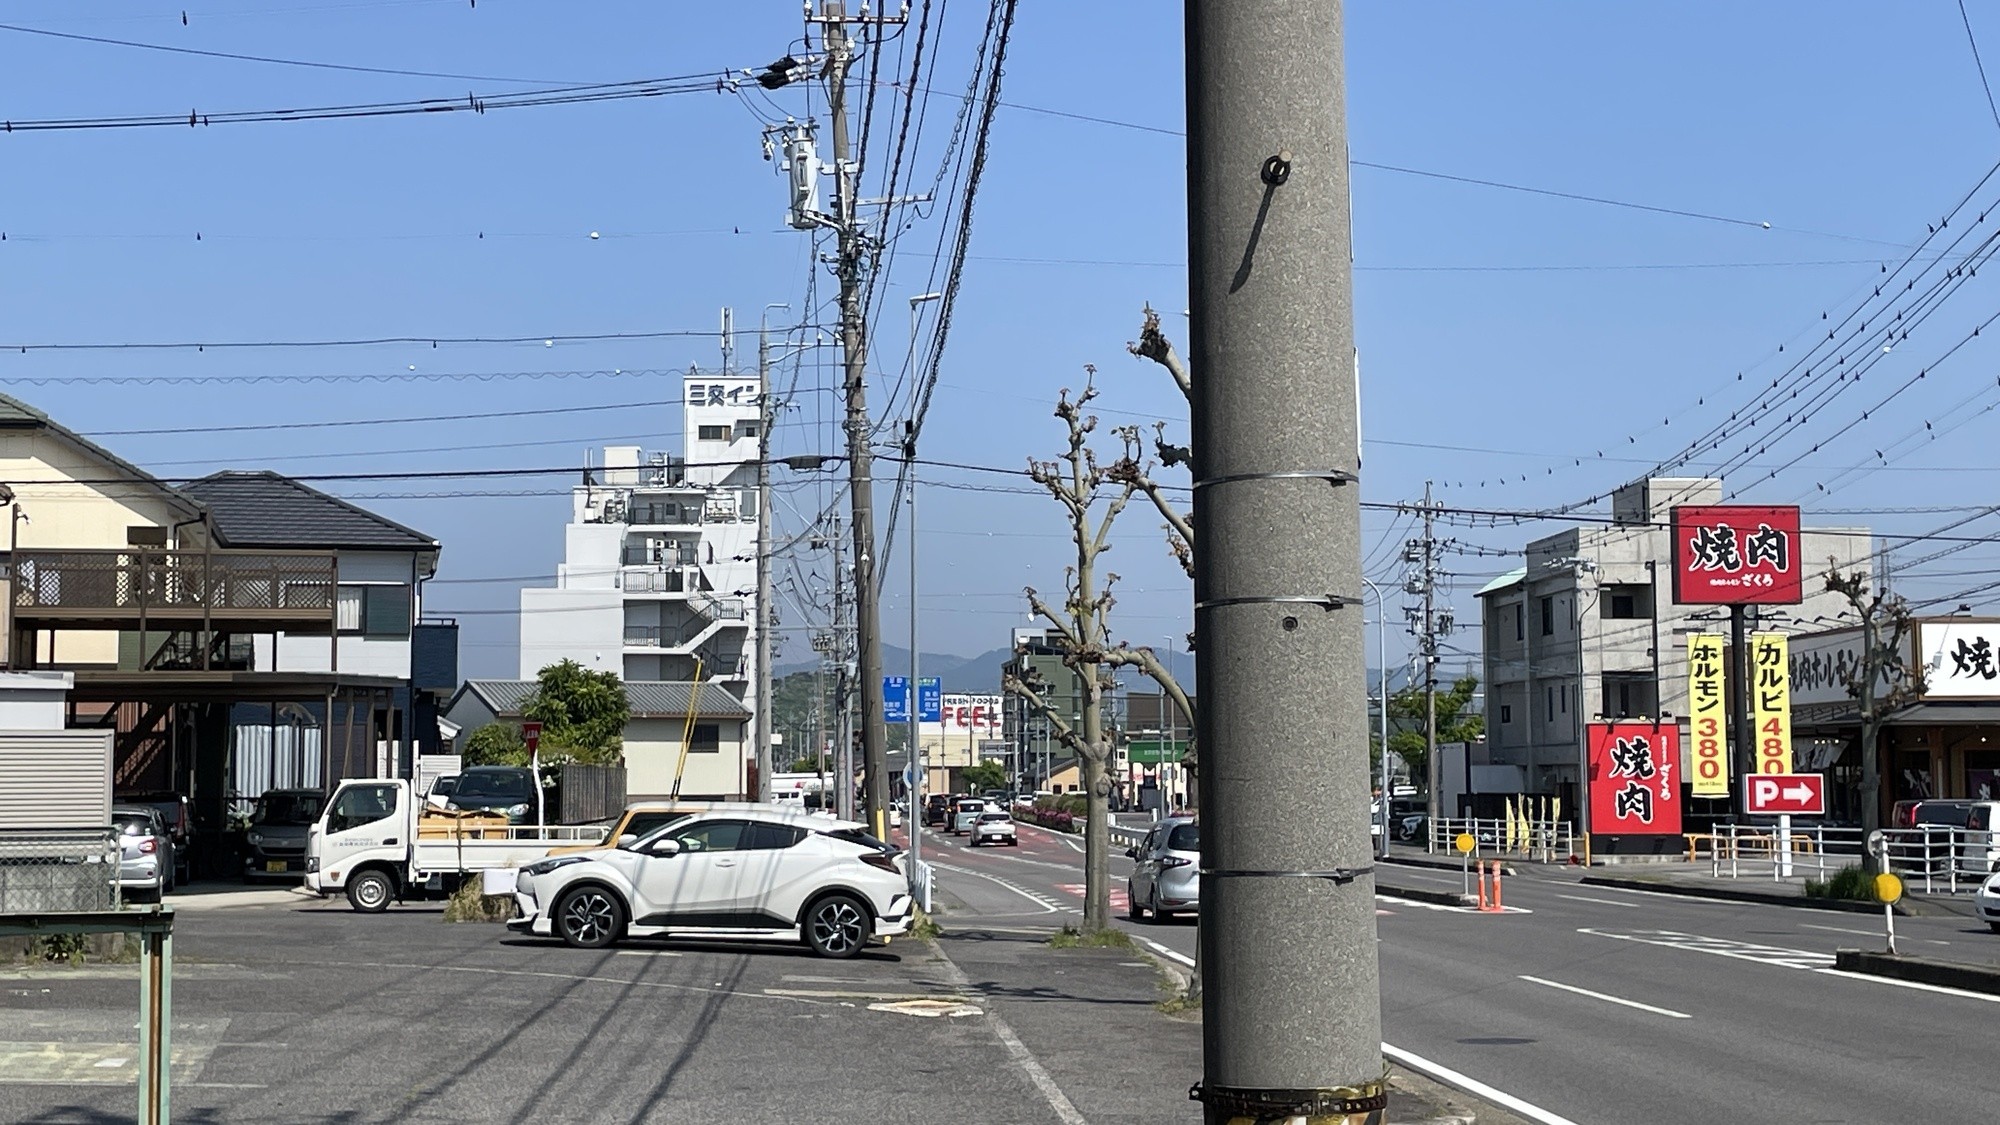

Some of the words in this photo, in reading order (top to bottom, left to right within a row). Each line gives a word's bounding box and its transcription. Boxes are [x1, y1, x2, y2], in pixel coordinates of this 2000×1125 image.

[1688, 523, 1790, 573] 焼肉
[1741, 573, 1774, 587] ざくろ
[1694, 644, 1719, 713] ホルモン
[1759, 643, 1783, 712] カルビ
[1950, 636, 2000, 680] 焼
[941, 706, 1001, 727] FEEL
[1698, 718, 1720, 779] 380
[1762, 718, 1784, 774] 480
[1608, 735, 1656, 825] 焼肉
[1755, 780, 1780, 808] P
